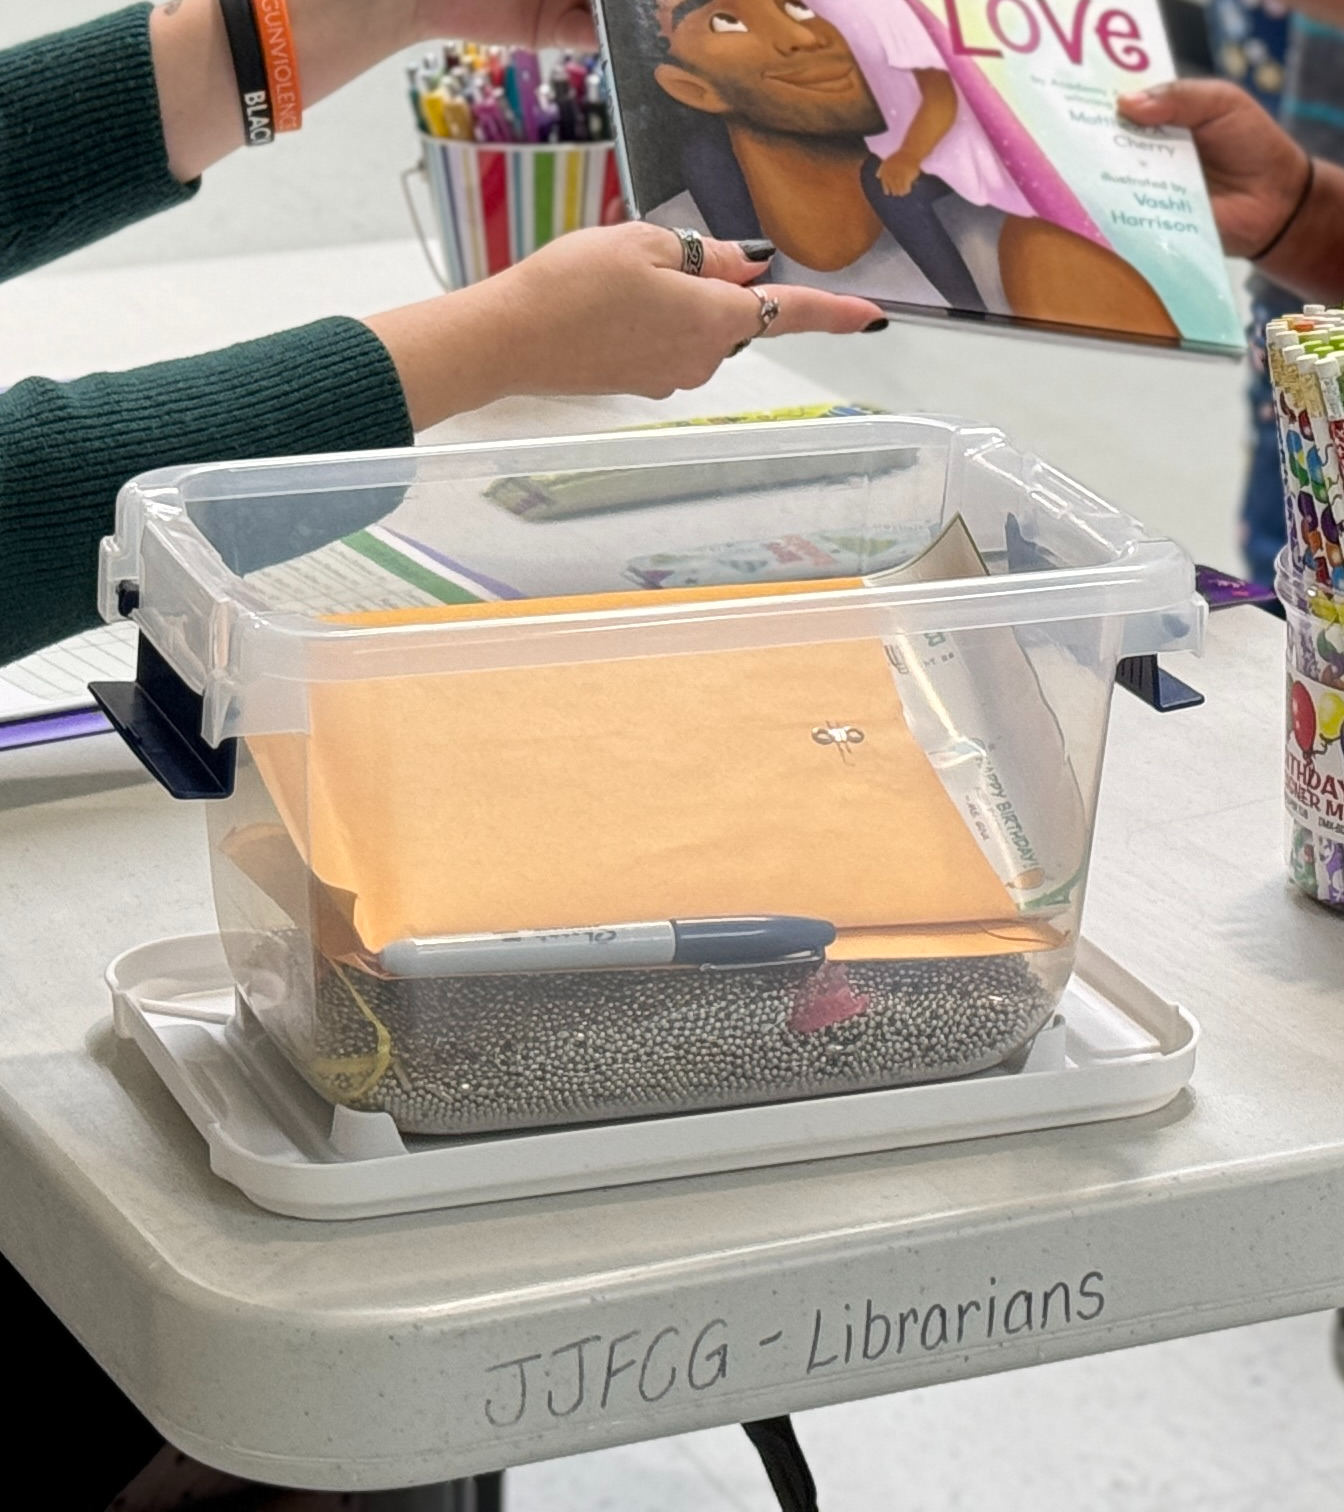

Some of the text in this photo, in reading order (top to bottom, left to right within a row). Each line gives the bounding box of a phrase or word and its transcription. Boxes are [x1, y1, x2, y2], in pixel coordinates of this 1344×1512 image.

[1113, 134, 1176, 158] Cherry
[1133, 191, 1193, 214] Vashti
[1110, 209, 1199, 234] Harrison
[806, 1270, 1106, 1376] Librarians
